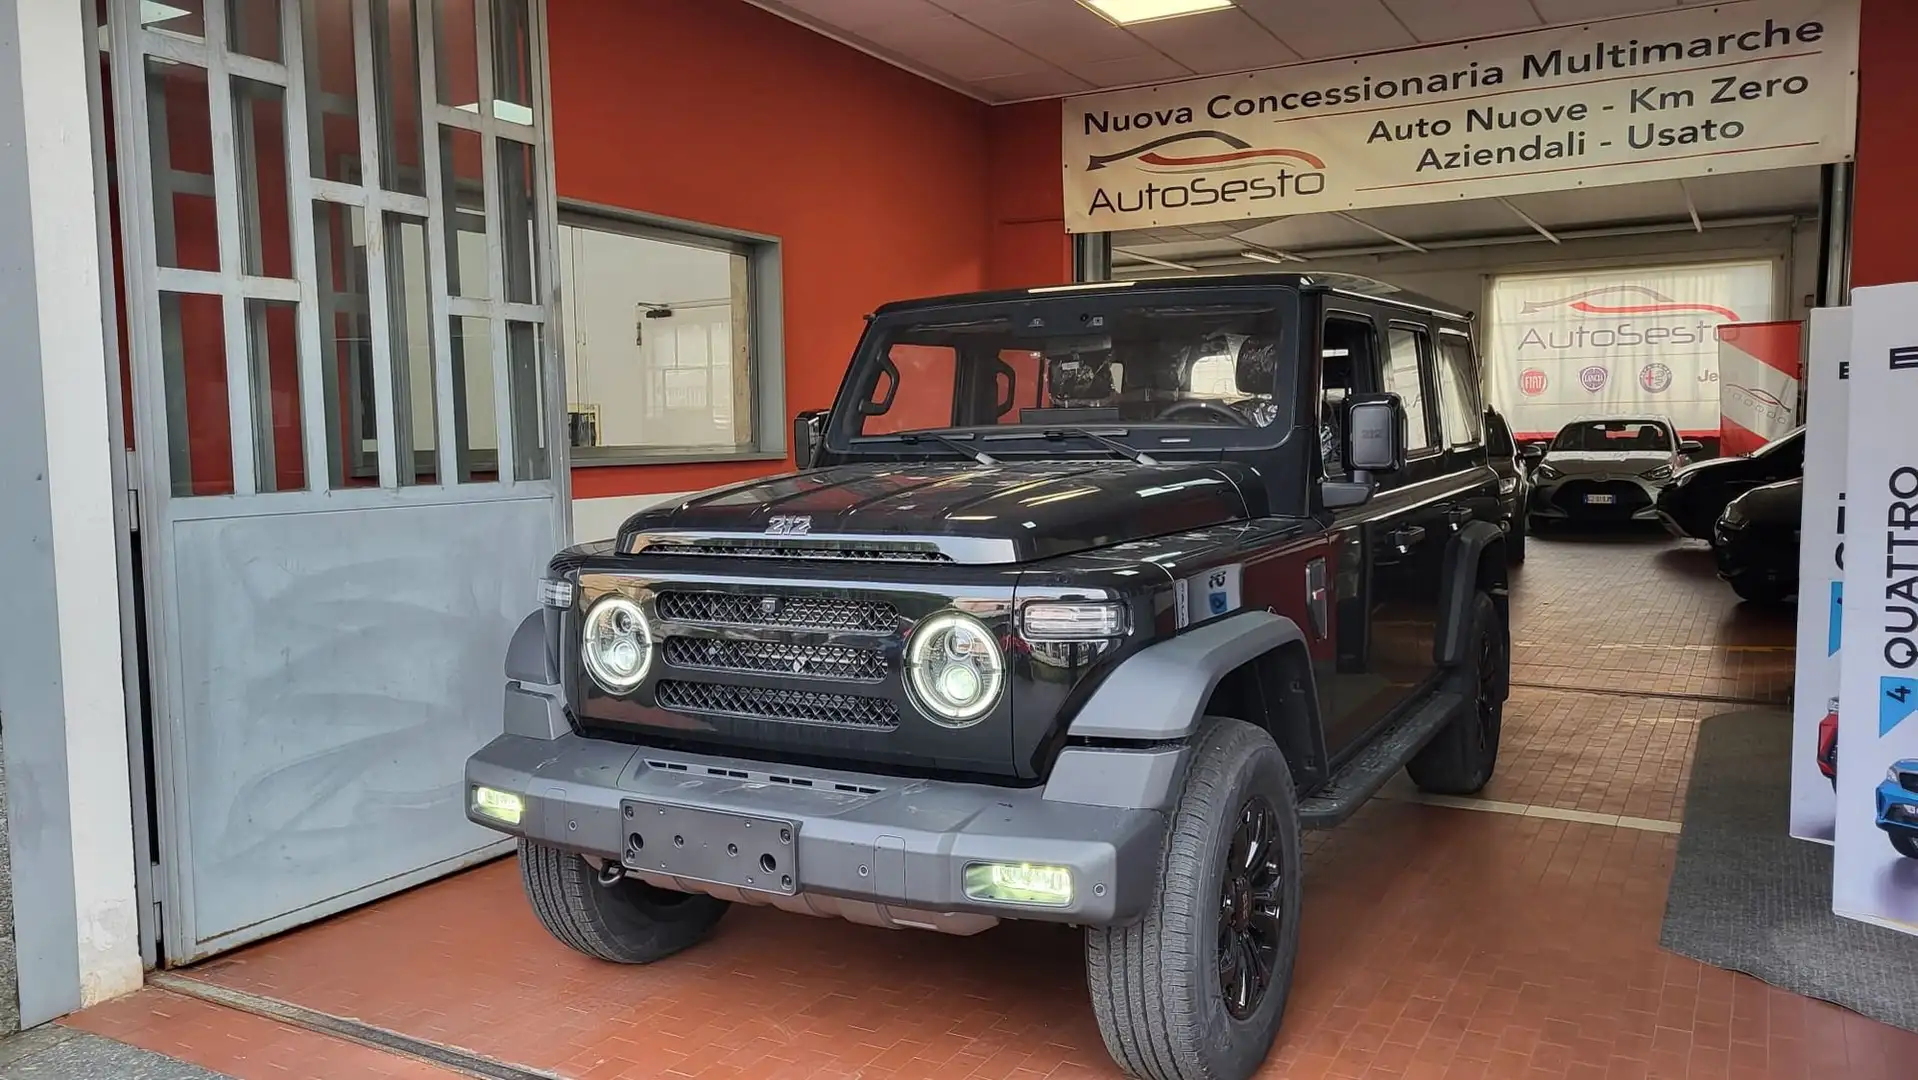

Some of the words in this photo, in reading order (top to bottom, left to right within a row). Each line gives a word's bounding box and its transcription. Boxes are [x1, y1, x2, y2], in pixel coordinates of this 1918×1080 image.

[1084, 105, 1193, 135] Nuova
[1207, 61, 1504, 119] Concessionaria
[1521, 18, 1824, 80] Multimarche
[1367, 116, 1451, 144] Auto
[1466, 102, 1588, 133] Nuove
[1629, 86, 1694, 114] Km
[1710, 74, 1809, 104] Zero
[1416, 130, 1586, 172] Aziendali
[1627, 118, 1744, 150] Usato
[1088, 168, 1326, 216] AutoSesto
[1518, 319, 1741, 351] AutoSesto
[1525, 375, 1543, 389] FIAT
[765, 514, 811, 536] 212
[1884, 466, 1918, 669] QUATTRO
[1886, 684, 1911, 703] 4
